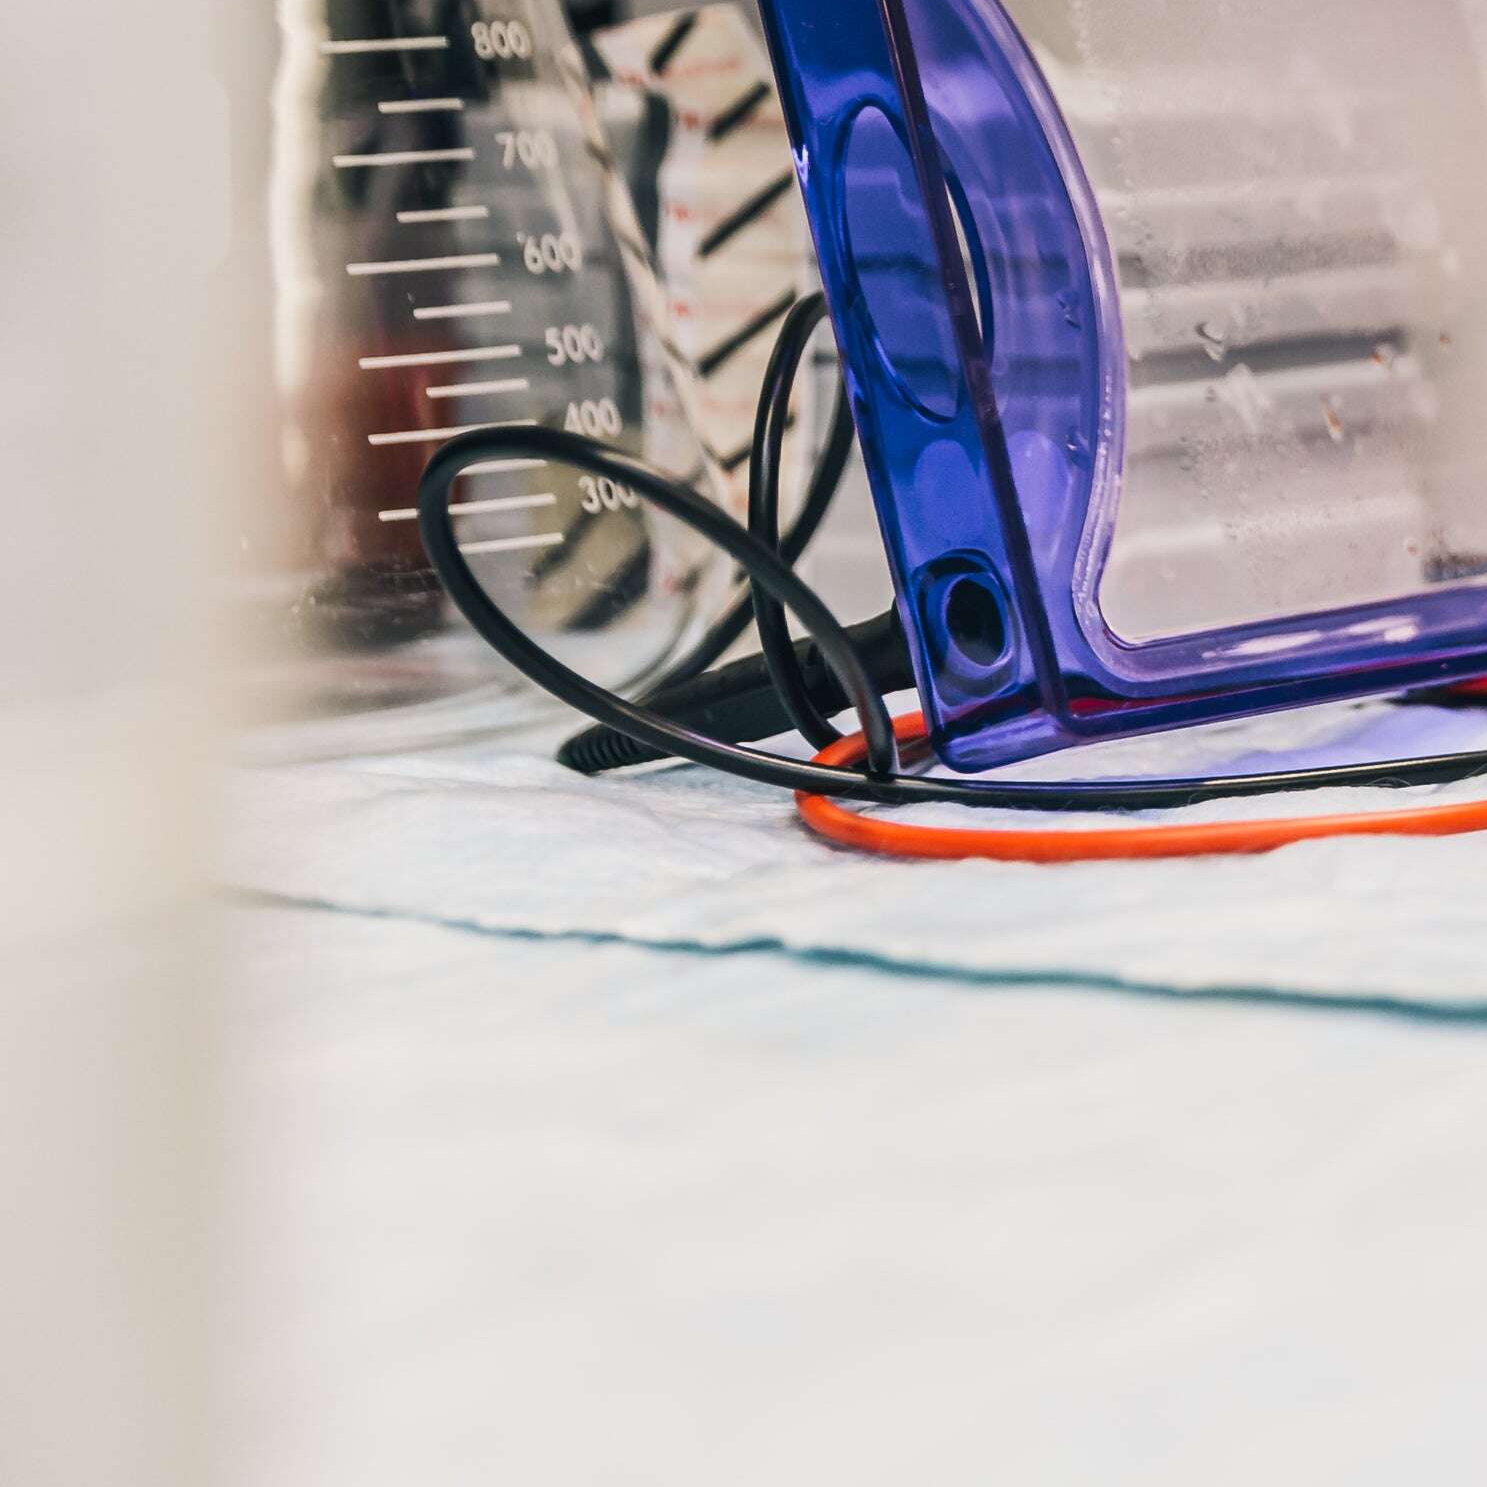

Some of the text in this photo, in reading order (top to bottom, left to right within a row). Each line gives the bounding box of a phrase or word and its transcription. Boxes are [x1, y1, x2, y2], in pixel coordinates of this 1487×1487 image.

[470, 21, 532, 60] 800
[494, 130, 557, 171] 700
[523, 233, 583, 275] 600
[544, 322, 604, 367] 500
[563, 397, 623, 438] 400
